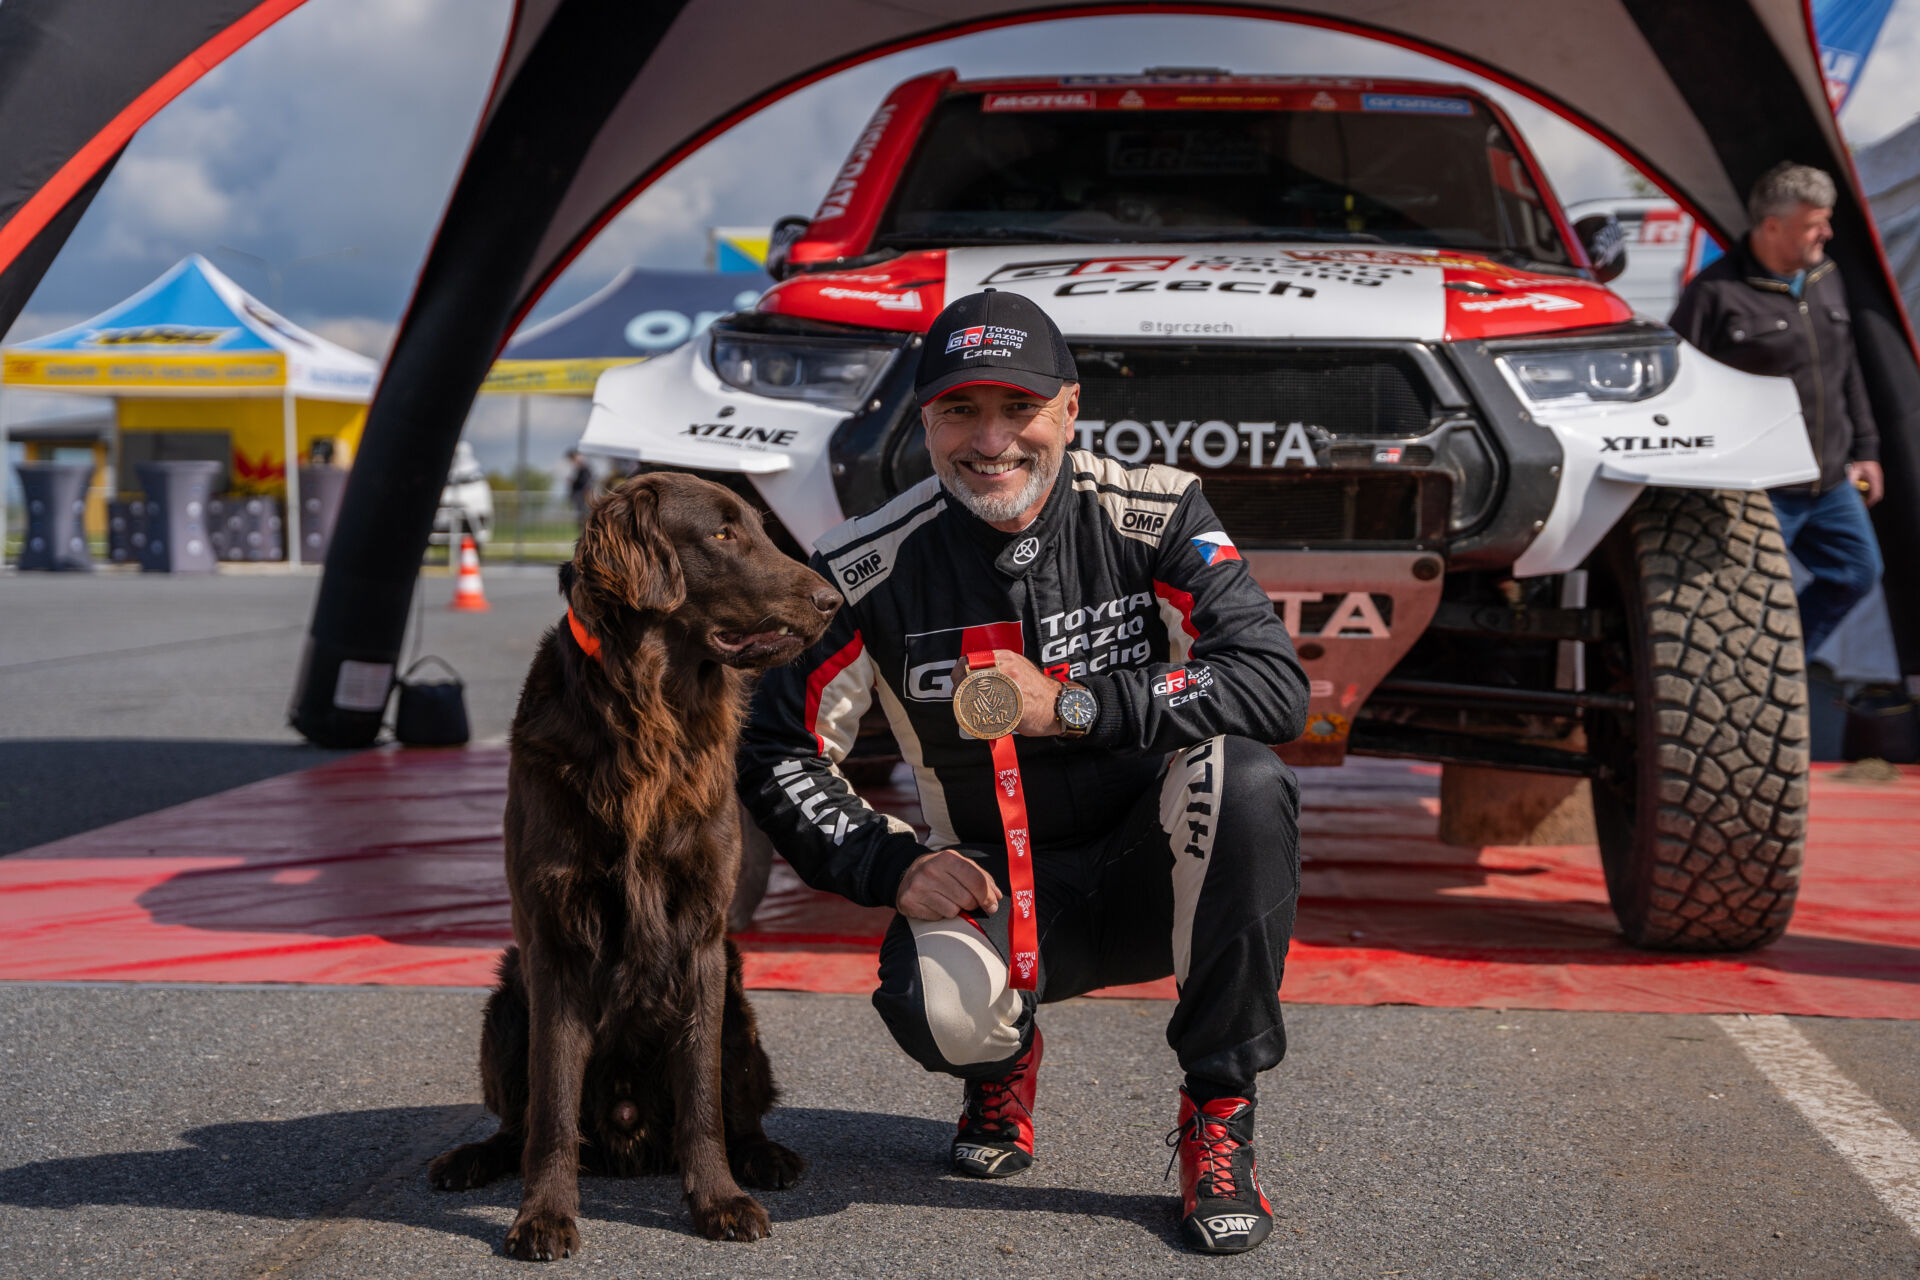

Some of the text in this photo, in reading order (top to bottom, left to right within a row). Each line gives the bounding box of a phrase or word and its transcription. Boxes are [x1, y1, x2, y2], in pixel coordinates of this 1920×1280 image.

[991, 94, 1087, 107] MOTUL
[1053, 278, 1317, 299] Czech
[986, 325, 1028, 338] TOYOTA
[1139, 320, 1234, 334] @tgrczech
[949, 333, 981, 348] GR
[983, 338, 1022, 349] Racing
[984, 332, 1024, 343] GAZOO
[963, 348, 1012, 360] Czech
[678, 423, 800, 446] XTLINE
[1074, 419, 1319, 469] TOYOTA
[1600, 435, 1716, 452] XTLINE
[1375, 449, 1401, 464] GR
[1122, 511, 1165, 534] OMP
[843, 553, 882, 586] OMP
[1153, 677, 1185, 695] GR
[1169, 690, 1209, 708] Czec
[1184, 738, 1214, 860] HILU
